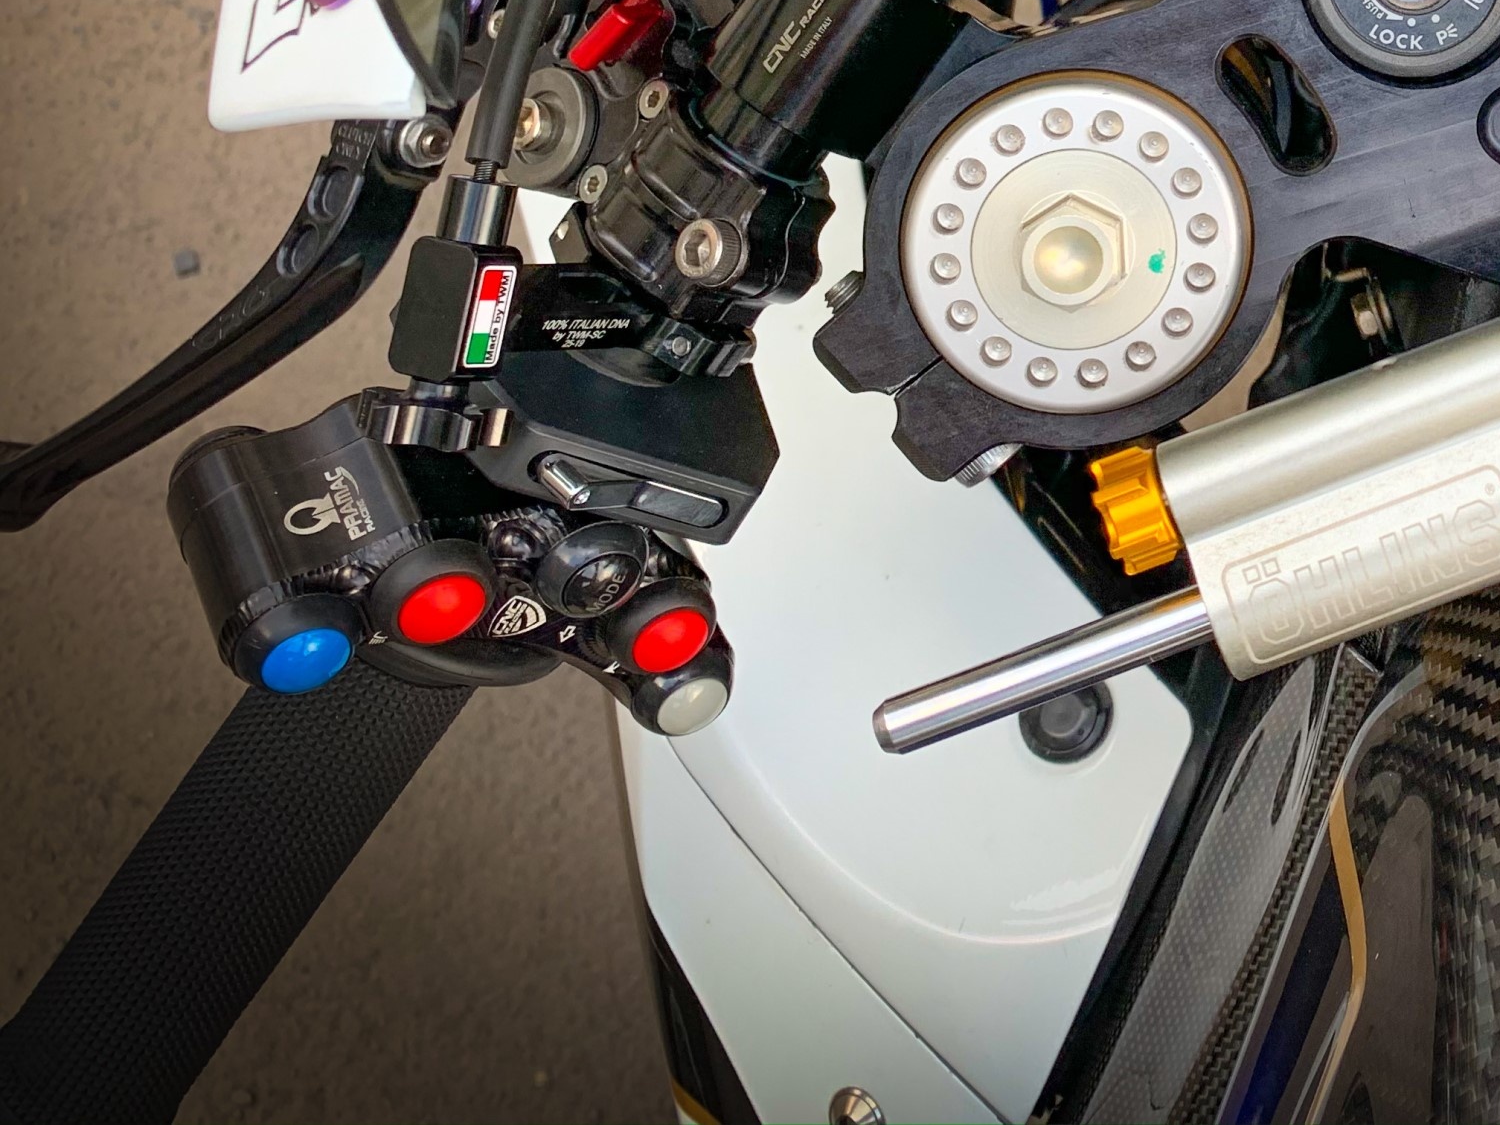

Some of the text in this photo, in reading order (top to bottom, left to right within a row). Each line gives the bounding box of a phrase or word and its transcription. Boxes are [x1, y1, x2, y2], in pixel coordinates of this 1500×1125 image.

[763, 20, 802, 74] CNC
[800, 16, 833, 59] MADE IN ITALY
[1369, 24, 1424, 51] LOCK
[485, 275, 510, 361] Made by TWM
[542, 318, 631, 331] 100% ITALIAN DNA
[552, 330, 607, 342] by TWM-SC
[323, 466, 368, 541] PRAMAC
[587, 573, 626, 613] MODE
[492, 597, 523, 635] CNC
